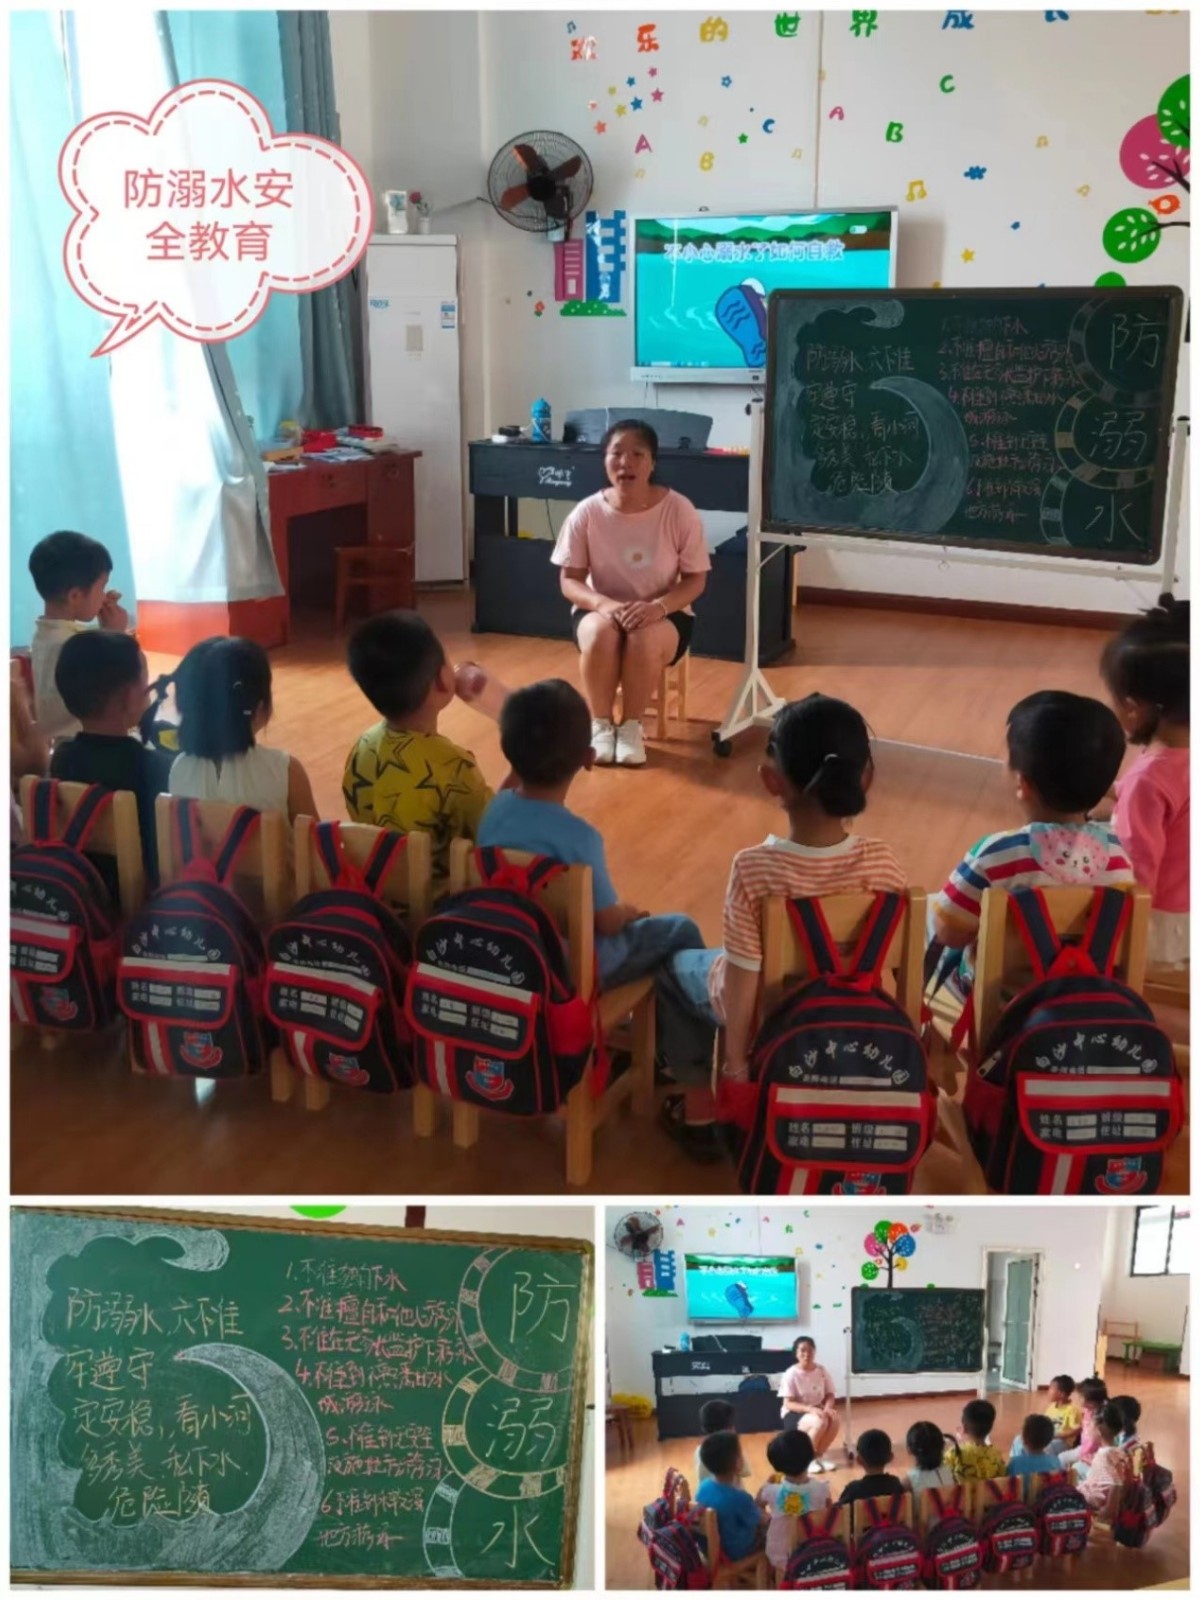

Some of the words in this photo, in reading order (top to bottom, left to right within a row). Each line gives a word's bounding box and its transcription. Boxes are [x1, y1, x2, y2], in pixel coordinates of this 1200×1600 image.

[664, 239, 845, 263] 不小心溺水了如何自救
[66, 1345, 155, 1390] 牢遵守
